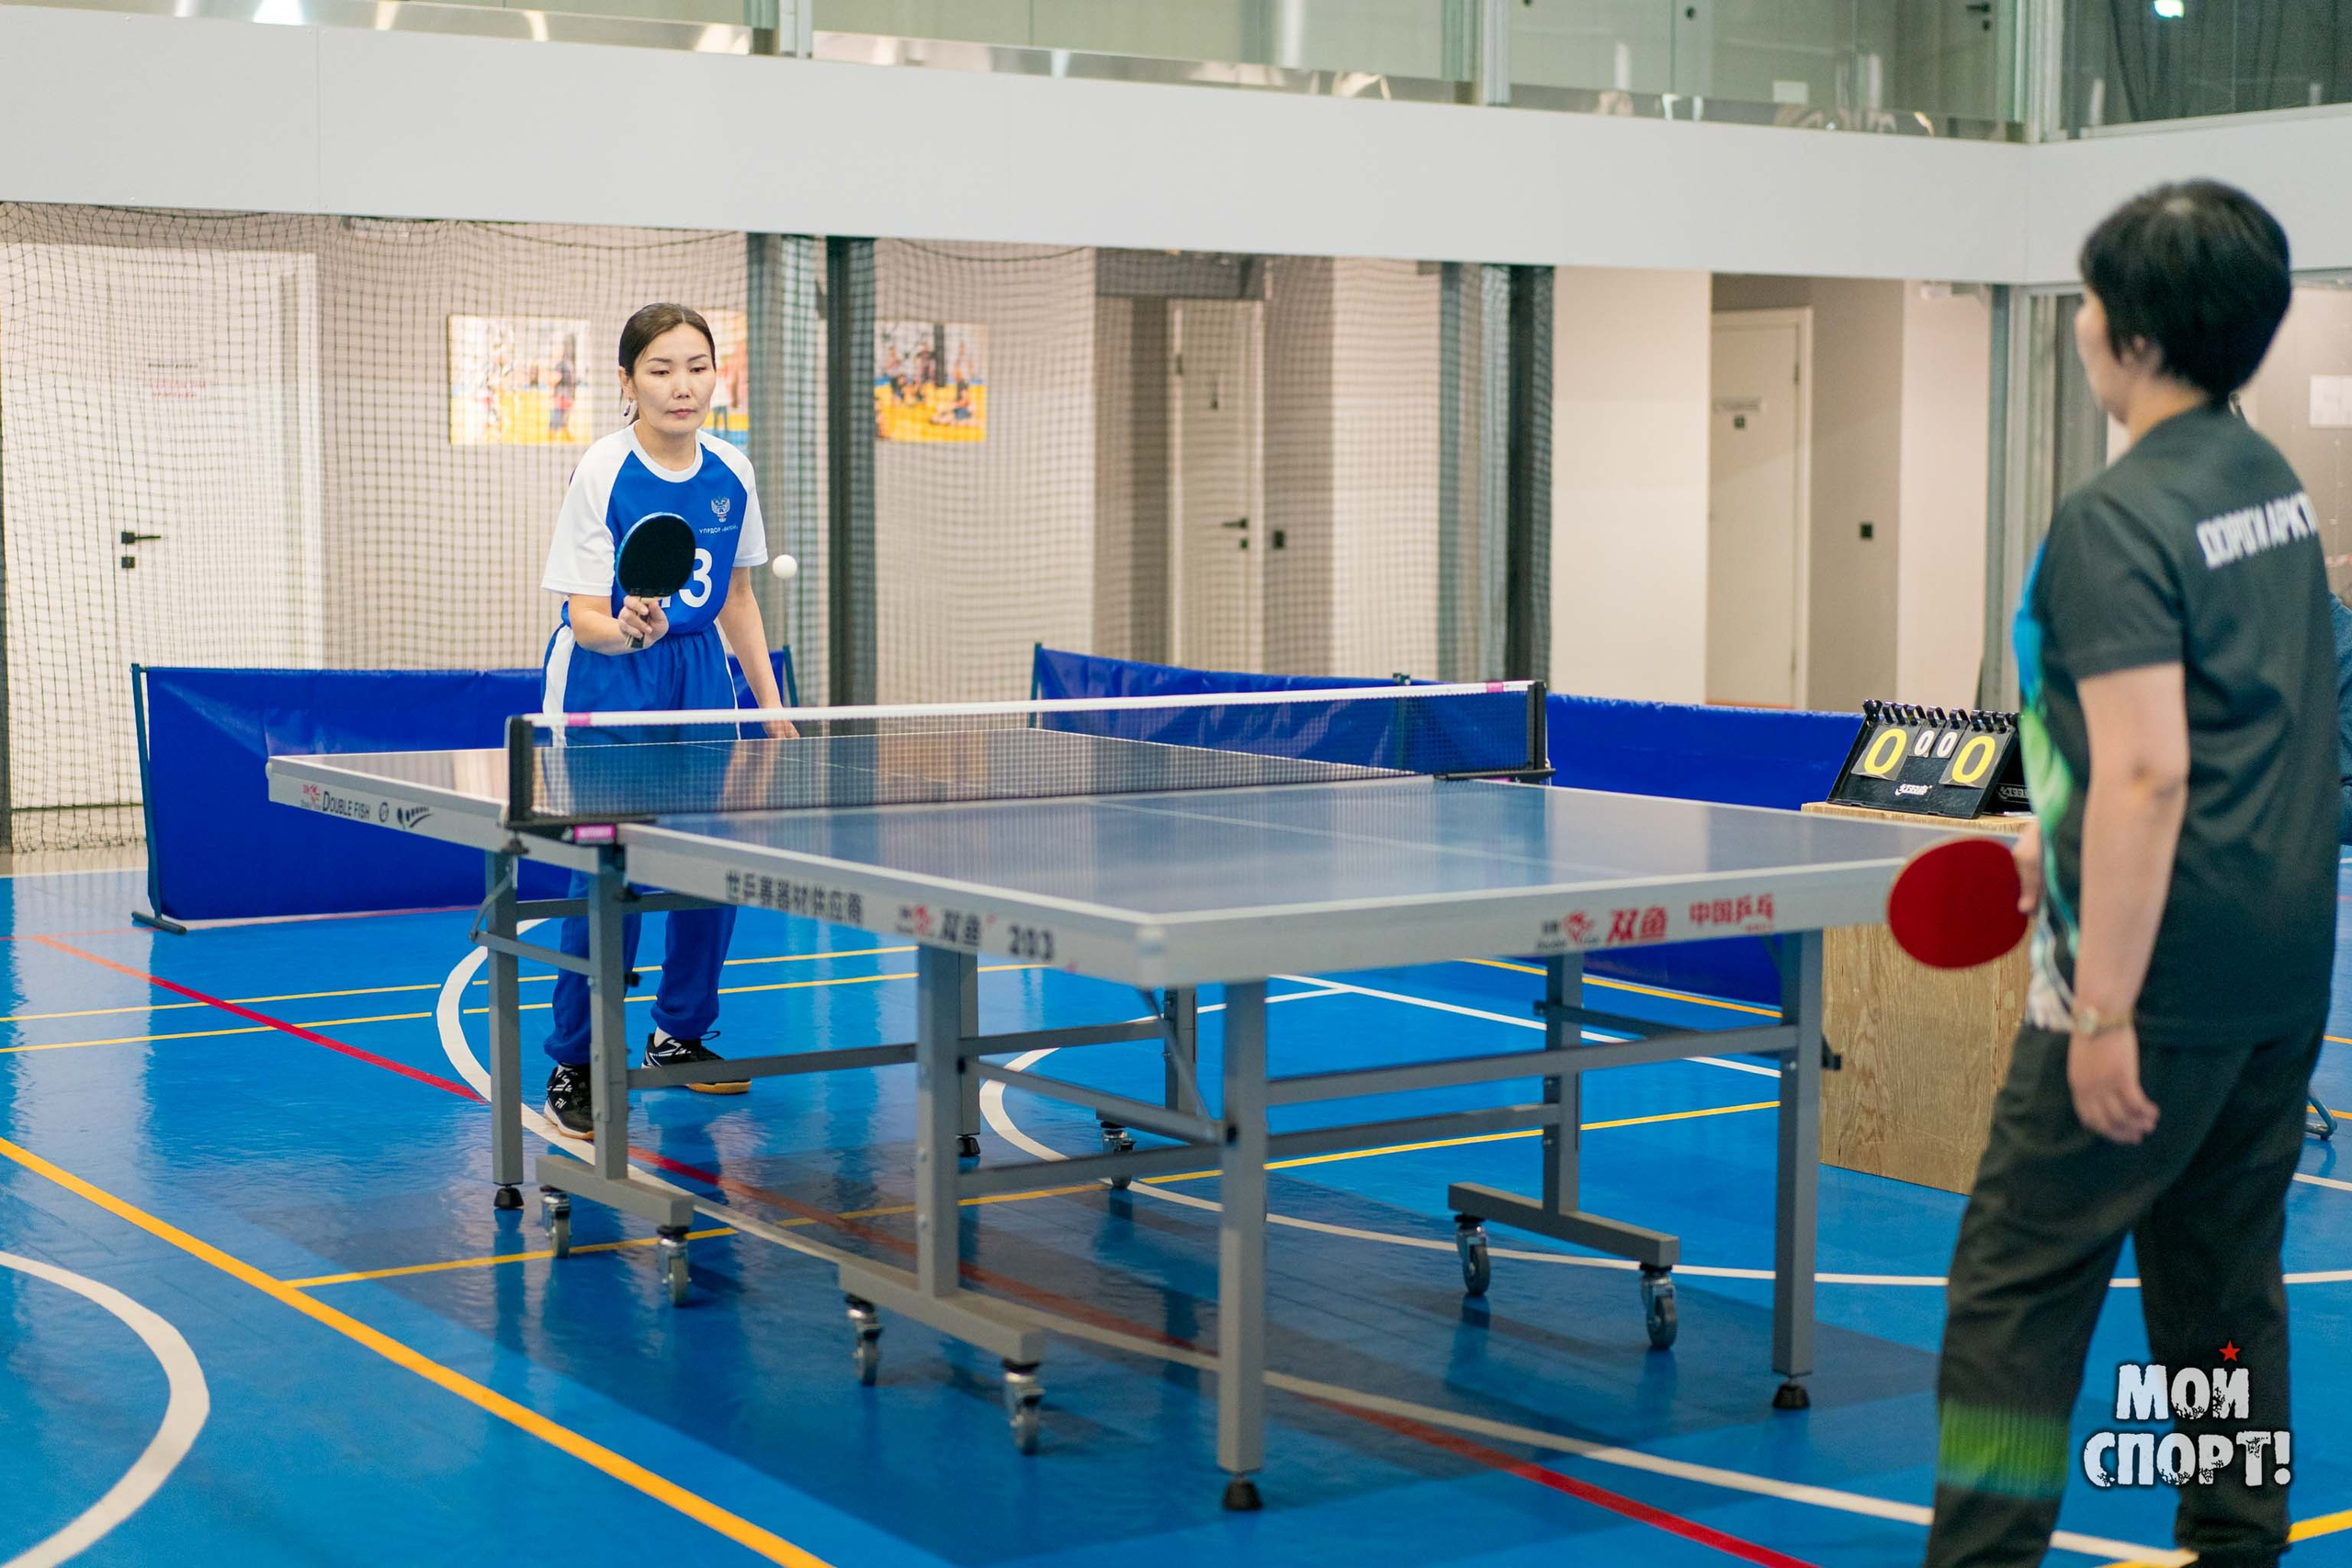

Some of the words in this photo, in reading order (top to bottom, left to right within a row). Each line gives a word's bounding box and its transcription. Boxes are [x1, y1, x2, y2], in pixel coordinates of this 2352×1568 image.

[1863, 728, 1907, 775] 0
[1914, 729, 1936, 757] 0
[1937, 731, 1958, 757] 0
[1951, 735, 1996, 784] 0
[322, 790, 353, 817] DOUBLE
[1606, 906, 1668, 947] 双鱼
